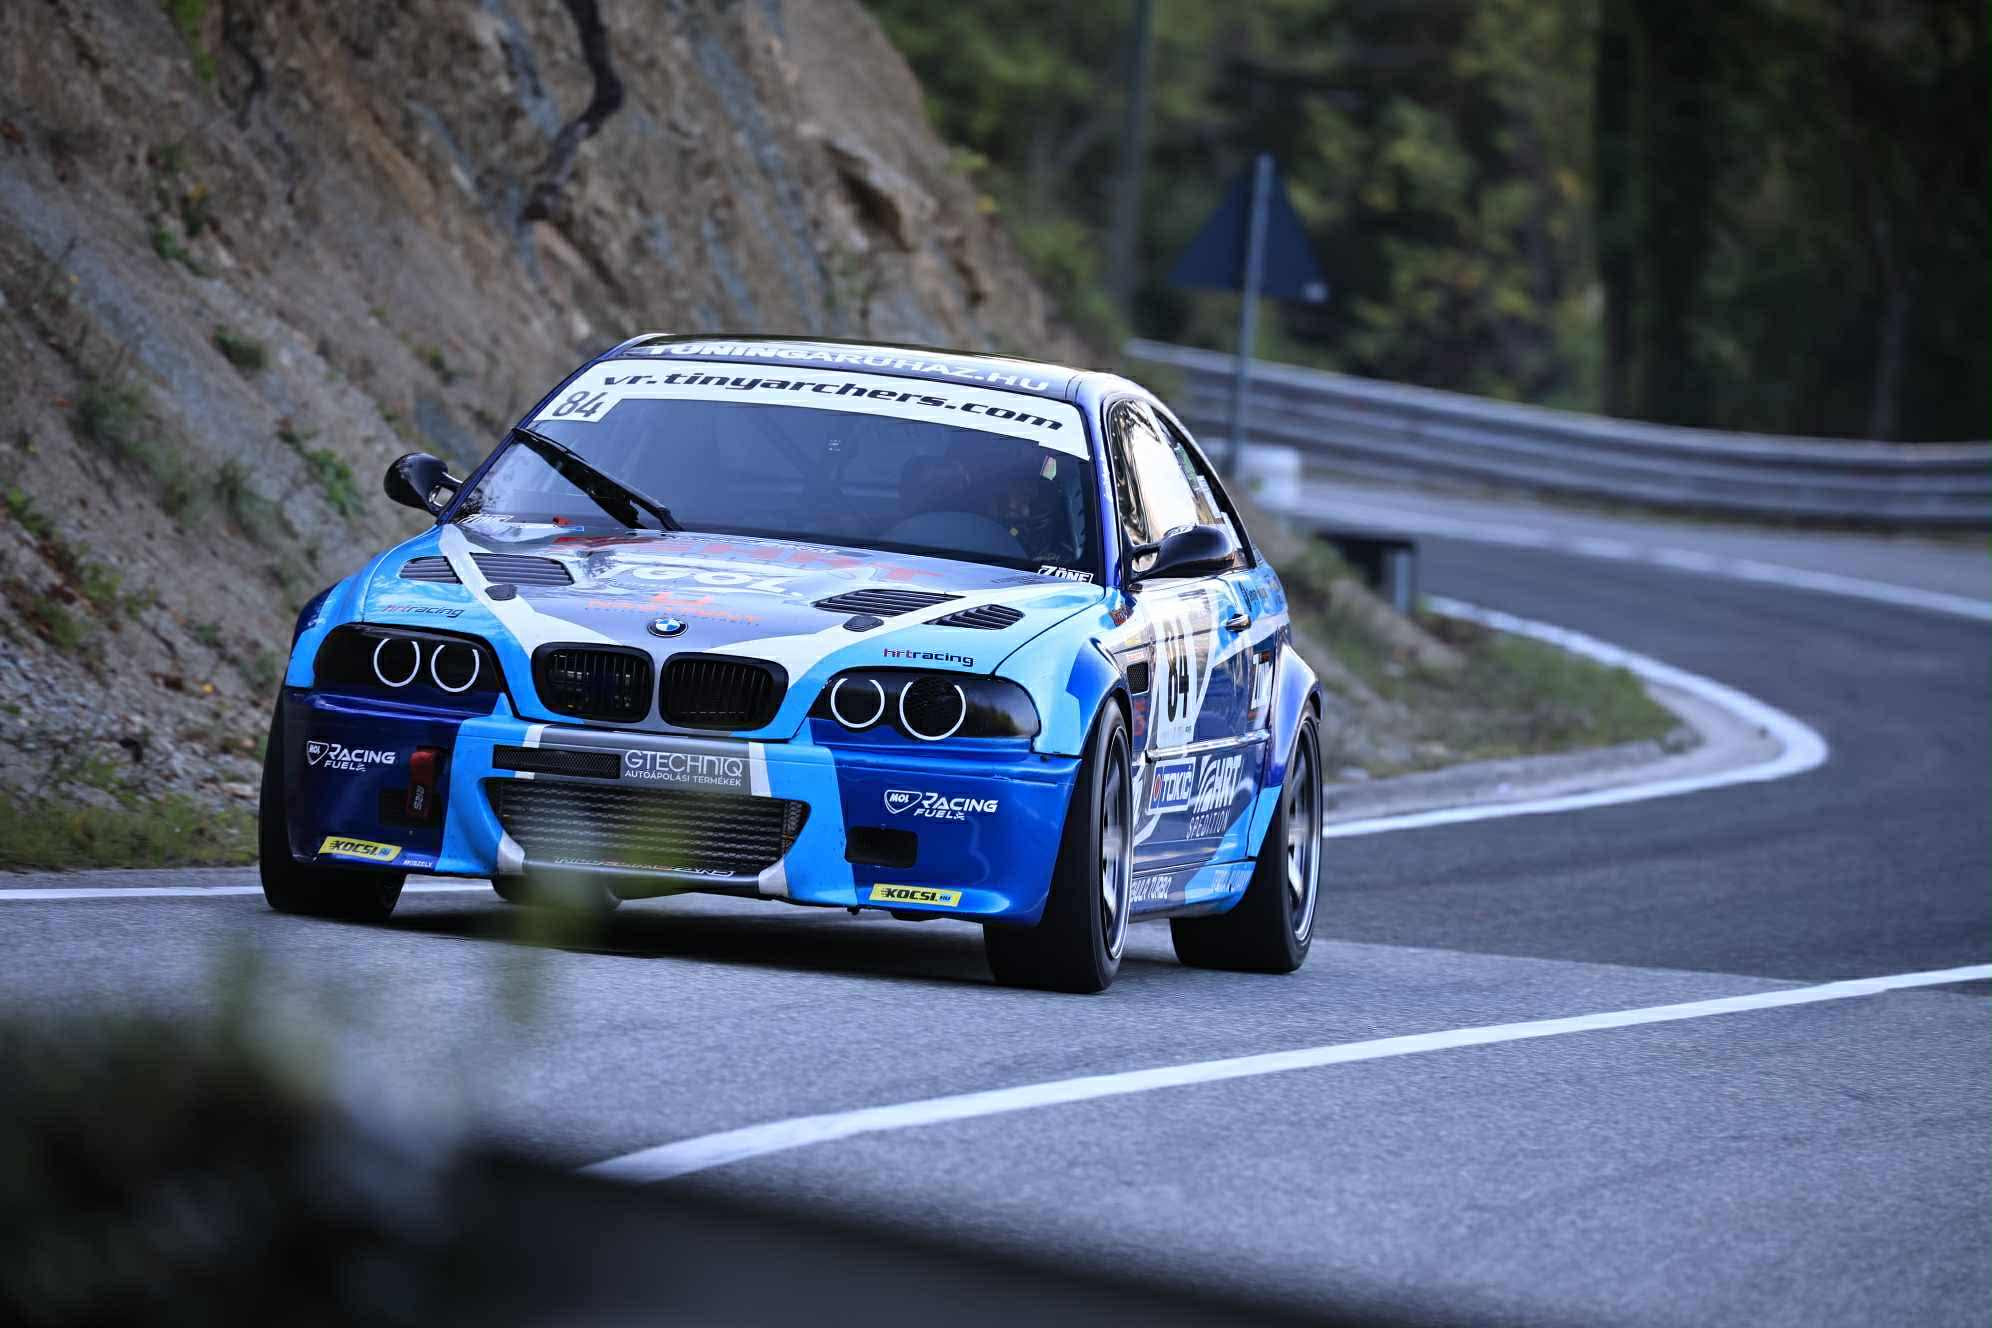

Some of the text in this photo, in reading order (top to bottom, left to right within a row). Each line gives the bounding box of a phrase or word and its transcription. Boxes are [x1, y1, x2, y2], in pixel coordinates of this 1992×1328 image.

[551, 390, 608, 418] 84
[604, 372, 1063, 431] vr.tinyarchers.com
[328, 743, 397, 764] RACING
[921, 792, 999, 813] RACING
